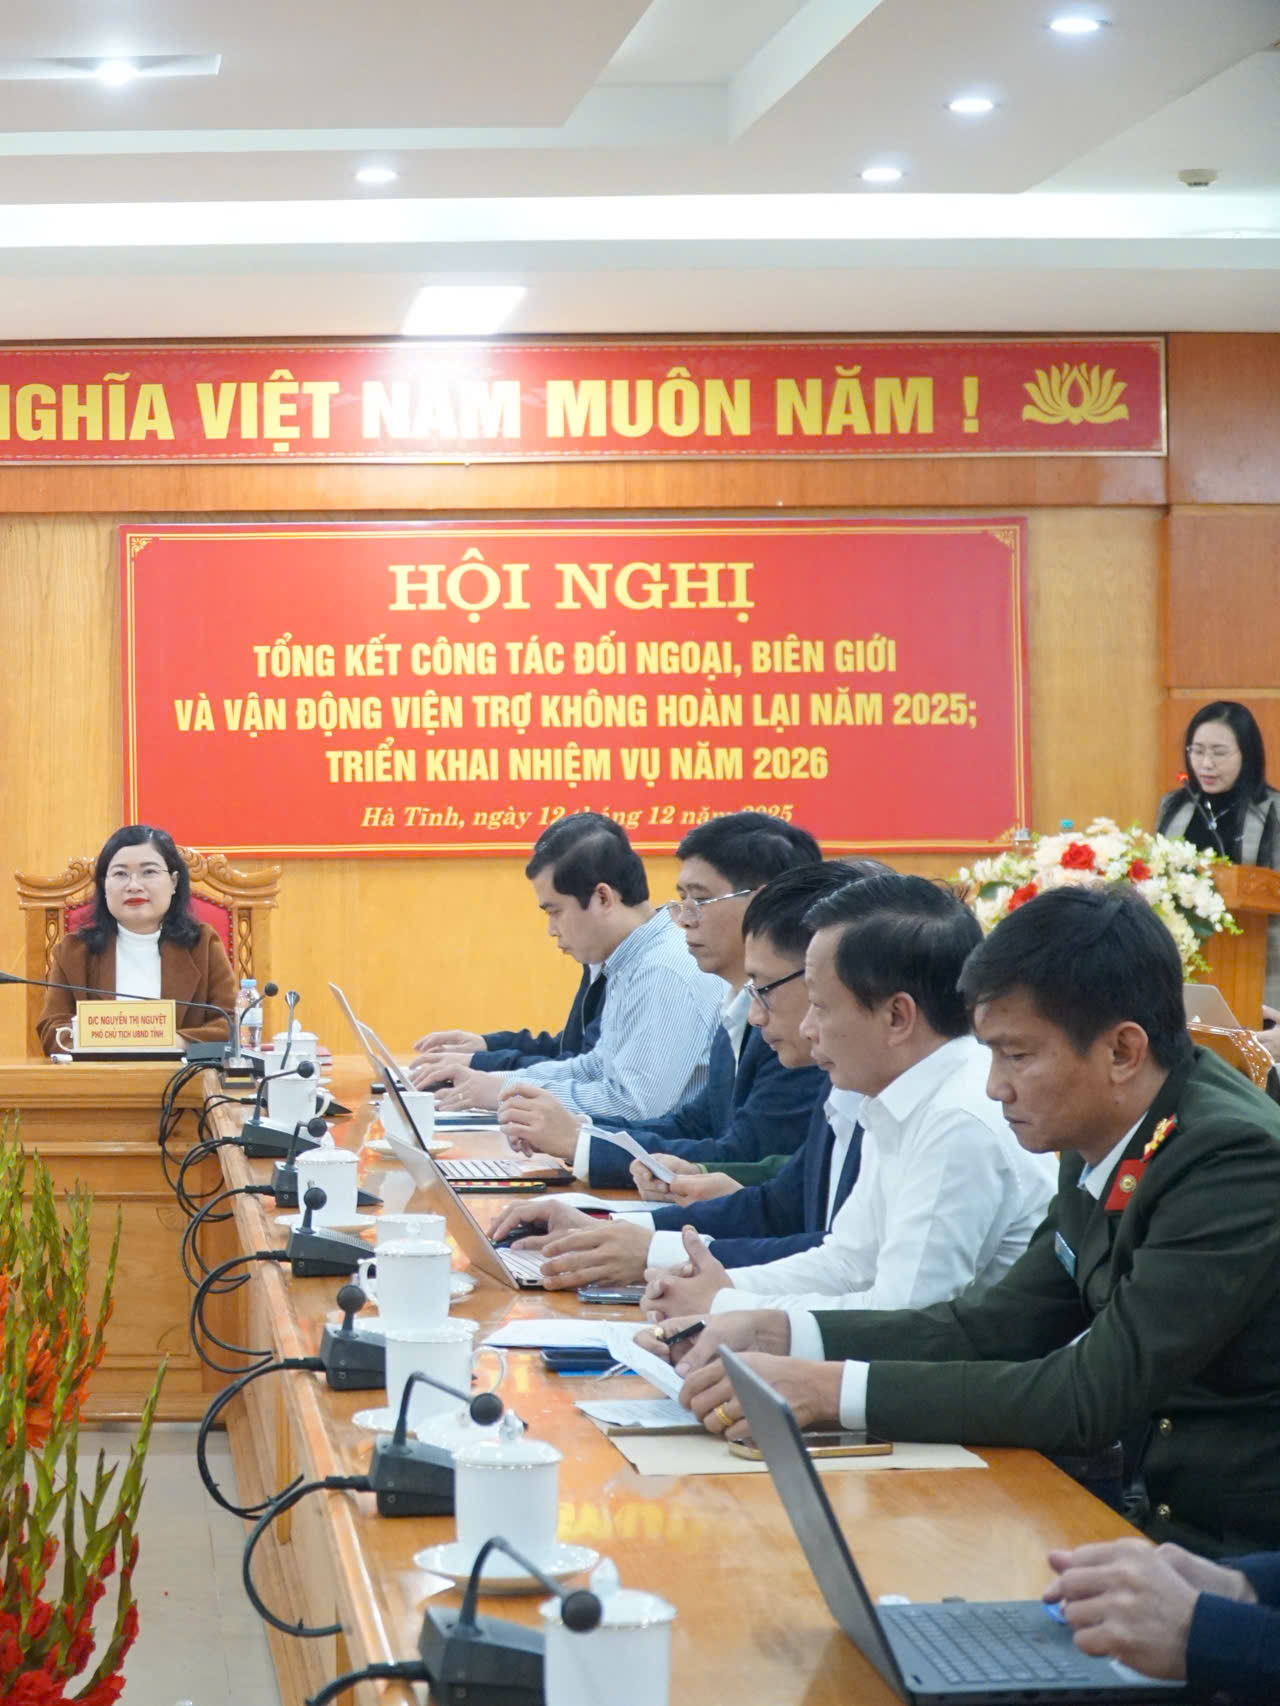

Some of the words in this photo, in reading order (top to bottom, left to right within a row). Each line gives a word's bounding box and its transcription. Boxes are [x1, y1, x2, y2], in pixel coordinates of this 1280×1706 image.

[196, 369, 340, 453] VIỆT
[362, 380, 520, 438] NAM
[546, 367, 751, 439] MUÔN
[777, 366, 933, 436] NĂM
[963, 377, 979, 433] !
[387, 547, 531, 624] HỘI
[554, 562, 755, 622] NGHỊ
[253, 631, 336, 678] TỔNG
[345, 632, 402, 677] KẾT
[410, 635, 497, 677] CÔNG
[505, 634, 564, 676] TÁC
[573, 629, 627, 675] ĐỐI
[636, 640, 742, 680] NGOẠI,
[752, 634, 824, 673] BIÊN
[835, 633, 896, 673] GIỚI
[174, 692, 215, 731] VÀ
[223, 691, 286, 738] VẬN
[296, 690, 382, 737] ĐỘNG
[390, 690, 461, 736] VIỆN
[472, 692, 533, 735] TRỢ
[541, 687, 648, 729] KHÔNG
[656, 687, 743, 728] HOÀN
[752, 693, 800, 734] LẠI
[810, 687, 883, 726] NĂM
[893, 692, 977, 730] 2025;
[326, 735, 417, 783] TRIỂN
[425, 747, 500, 782] KHAI
[509, 741, 611, 788] NHIỆM
[620, 747, 660, 788] VỤ
[670, 740, 743, 781] NĂM
[754, 746, 828, 780] 2026
[361, 806, 395, 828] Hà
[404, 805, 466, 830] Tĩnh,
[472, 805, 532, 831] ngày
[538, 806, 566, 826] 12
[649, 805, 675, 825] 12
